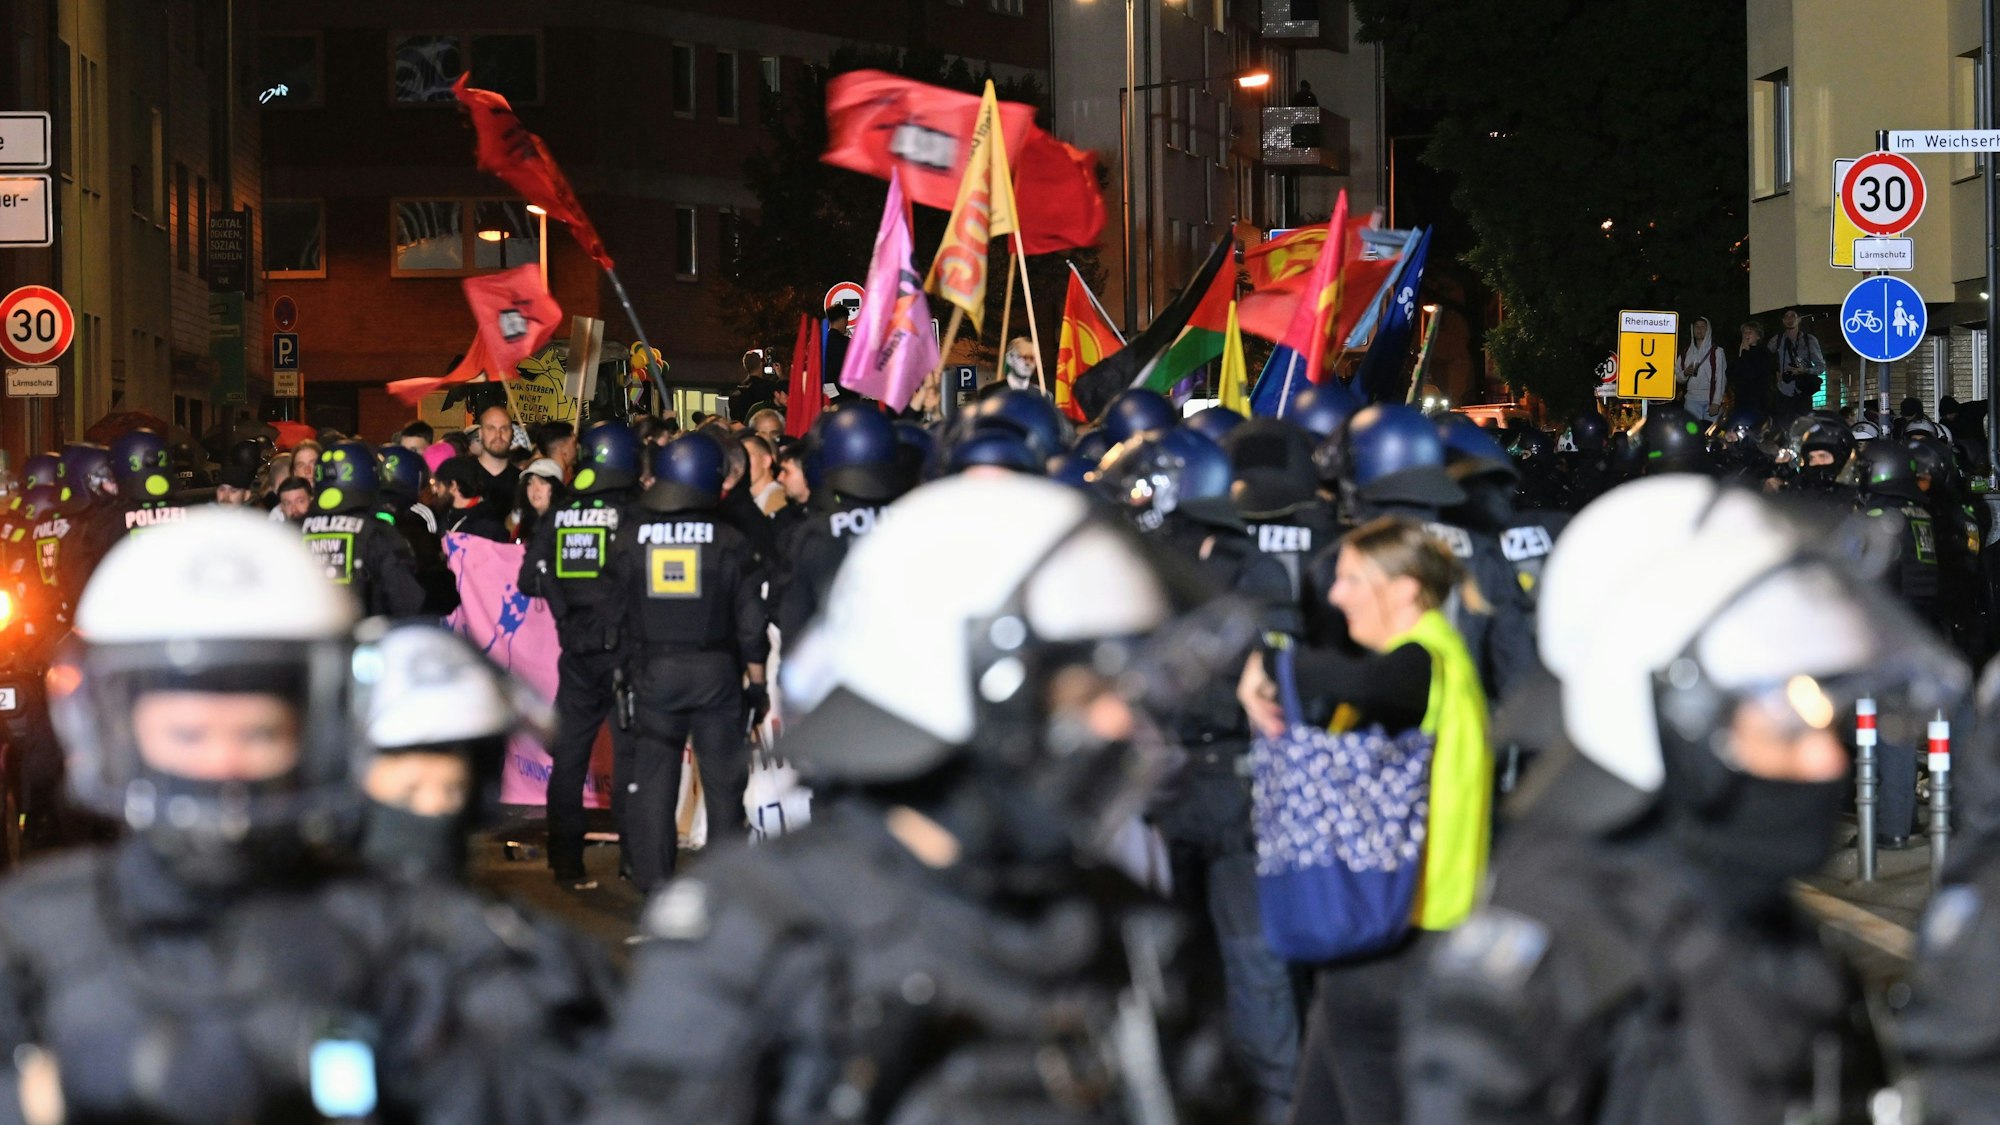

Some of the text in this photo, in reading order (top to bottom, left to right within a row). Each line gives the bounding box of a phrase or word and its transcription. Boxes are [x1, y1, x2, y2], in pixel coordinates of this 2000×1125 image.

[1897, 135, 1915, 148] Im
[1860, 176, 1906, 212] 30
[210, 218, 243, 229] DIGITAL
[210, 240, 243, 251] SOZIAL
[1860, 251, 1906, 259] Lärmschutz
[13, 309, 55, 342] 30
[1625, 316, 1672, 326] Rheinaustr.
[279, 338, 293, 365] P
[1641, 338, 1655, 356] U
[960, 368, 973, 387] P
[158, 450, 168, 467] 2
[341, 462, 354, 481] 2
[302, 515, 365, 533] POLIZEI
[566, 534, 594, 547] NRW
[637, 522, 714, 544] POLIZEI
[311, 540, 341, 553] NRW
